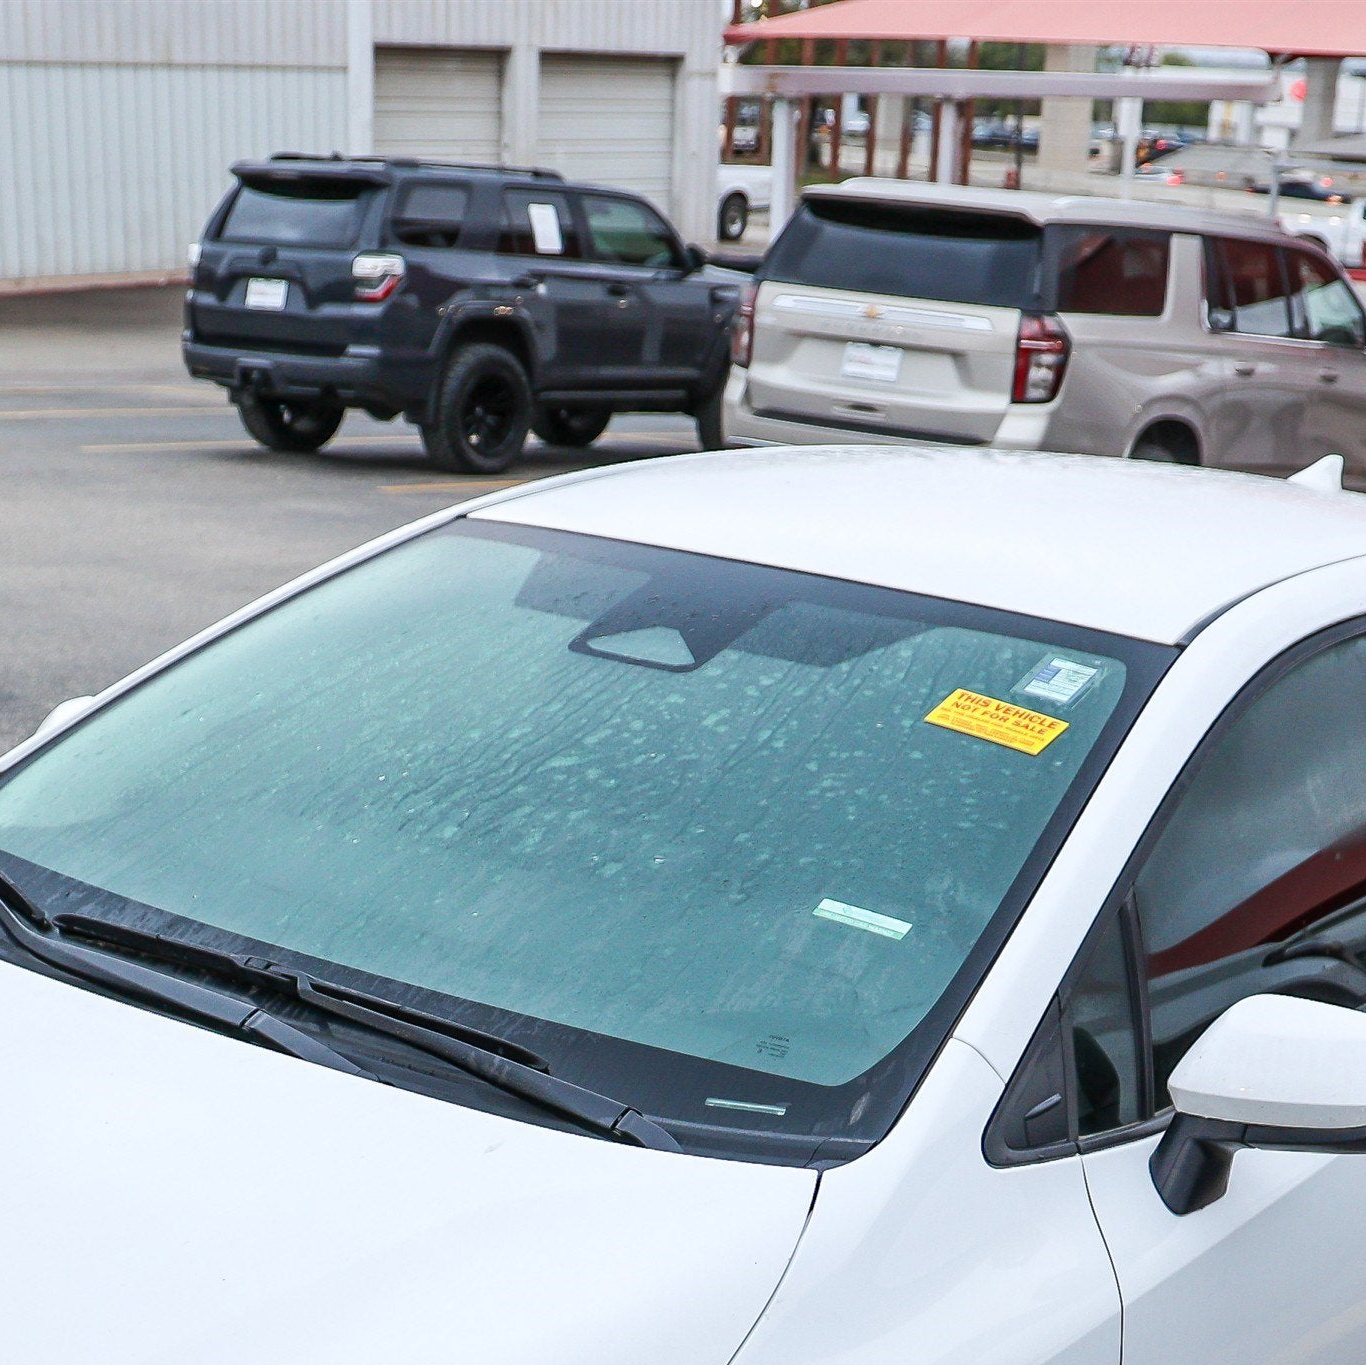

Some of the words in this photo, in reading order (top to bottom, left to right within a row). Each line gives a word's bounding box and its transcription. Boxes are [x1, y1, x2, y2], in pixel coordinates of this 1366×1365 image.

[951, 700, 979, 713] NOT
[981, 709, 1010, 723] FOR
[1011, 720, 1048, 735] SALE
[957, 692, 992, 708] THIS
[995, 700, 1061, 730] VEHICLE
